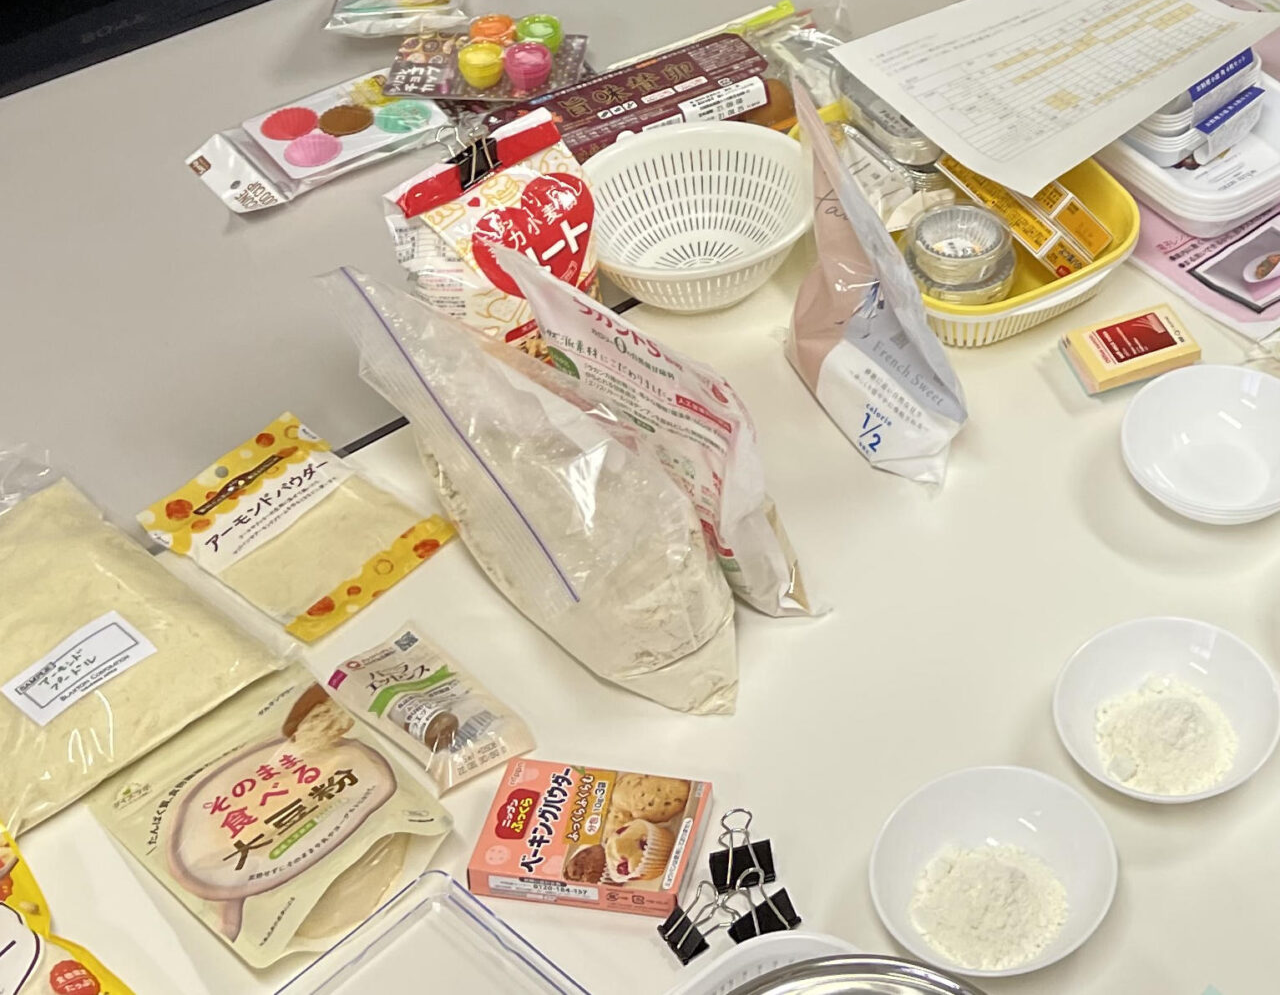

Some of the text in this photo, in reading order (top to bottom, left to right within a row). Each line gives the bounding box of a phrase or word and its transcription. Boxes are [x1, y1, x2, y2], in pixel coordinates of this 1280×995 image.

[404, 66, 424, 93] チョコ
[420, 66, 441, 93] カップ
[872, 340, 944, 406] French Sweet
[859, 412, 883, 453] 1/2
[865, 403, 892, 427] calorie
[205, 460, 328, 553] アーモンドパウダー
[20, 667, 53, 693] SAMPLE
[207, 754, 303, 816] そのまま
[220, 766, 321, 839] 食べる
[567, 774, 595, 842] ふっくらふくらむ
[222, 768, 359, 871] 大豆粉
[502, 798, 519, 828] ニップン
[511, 797, 533, 833] ふっくら
[520, 767, 573, 873] ベーキングパウダー
